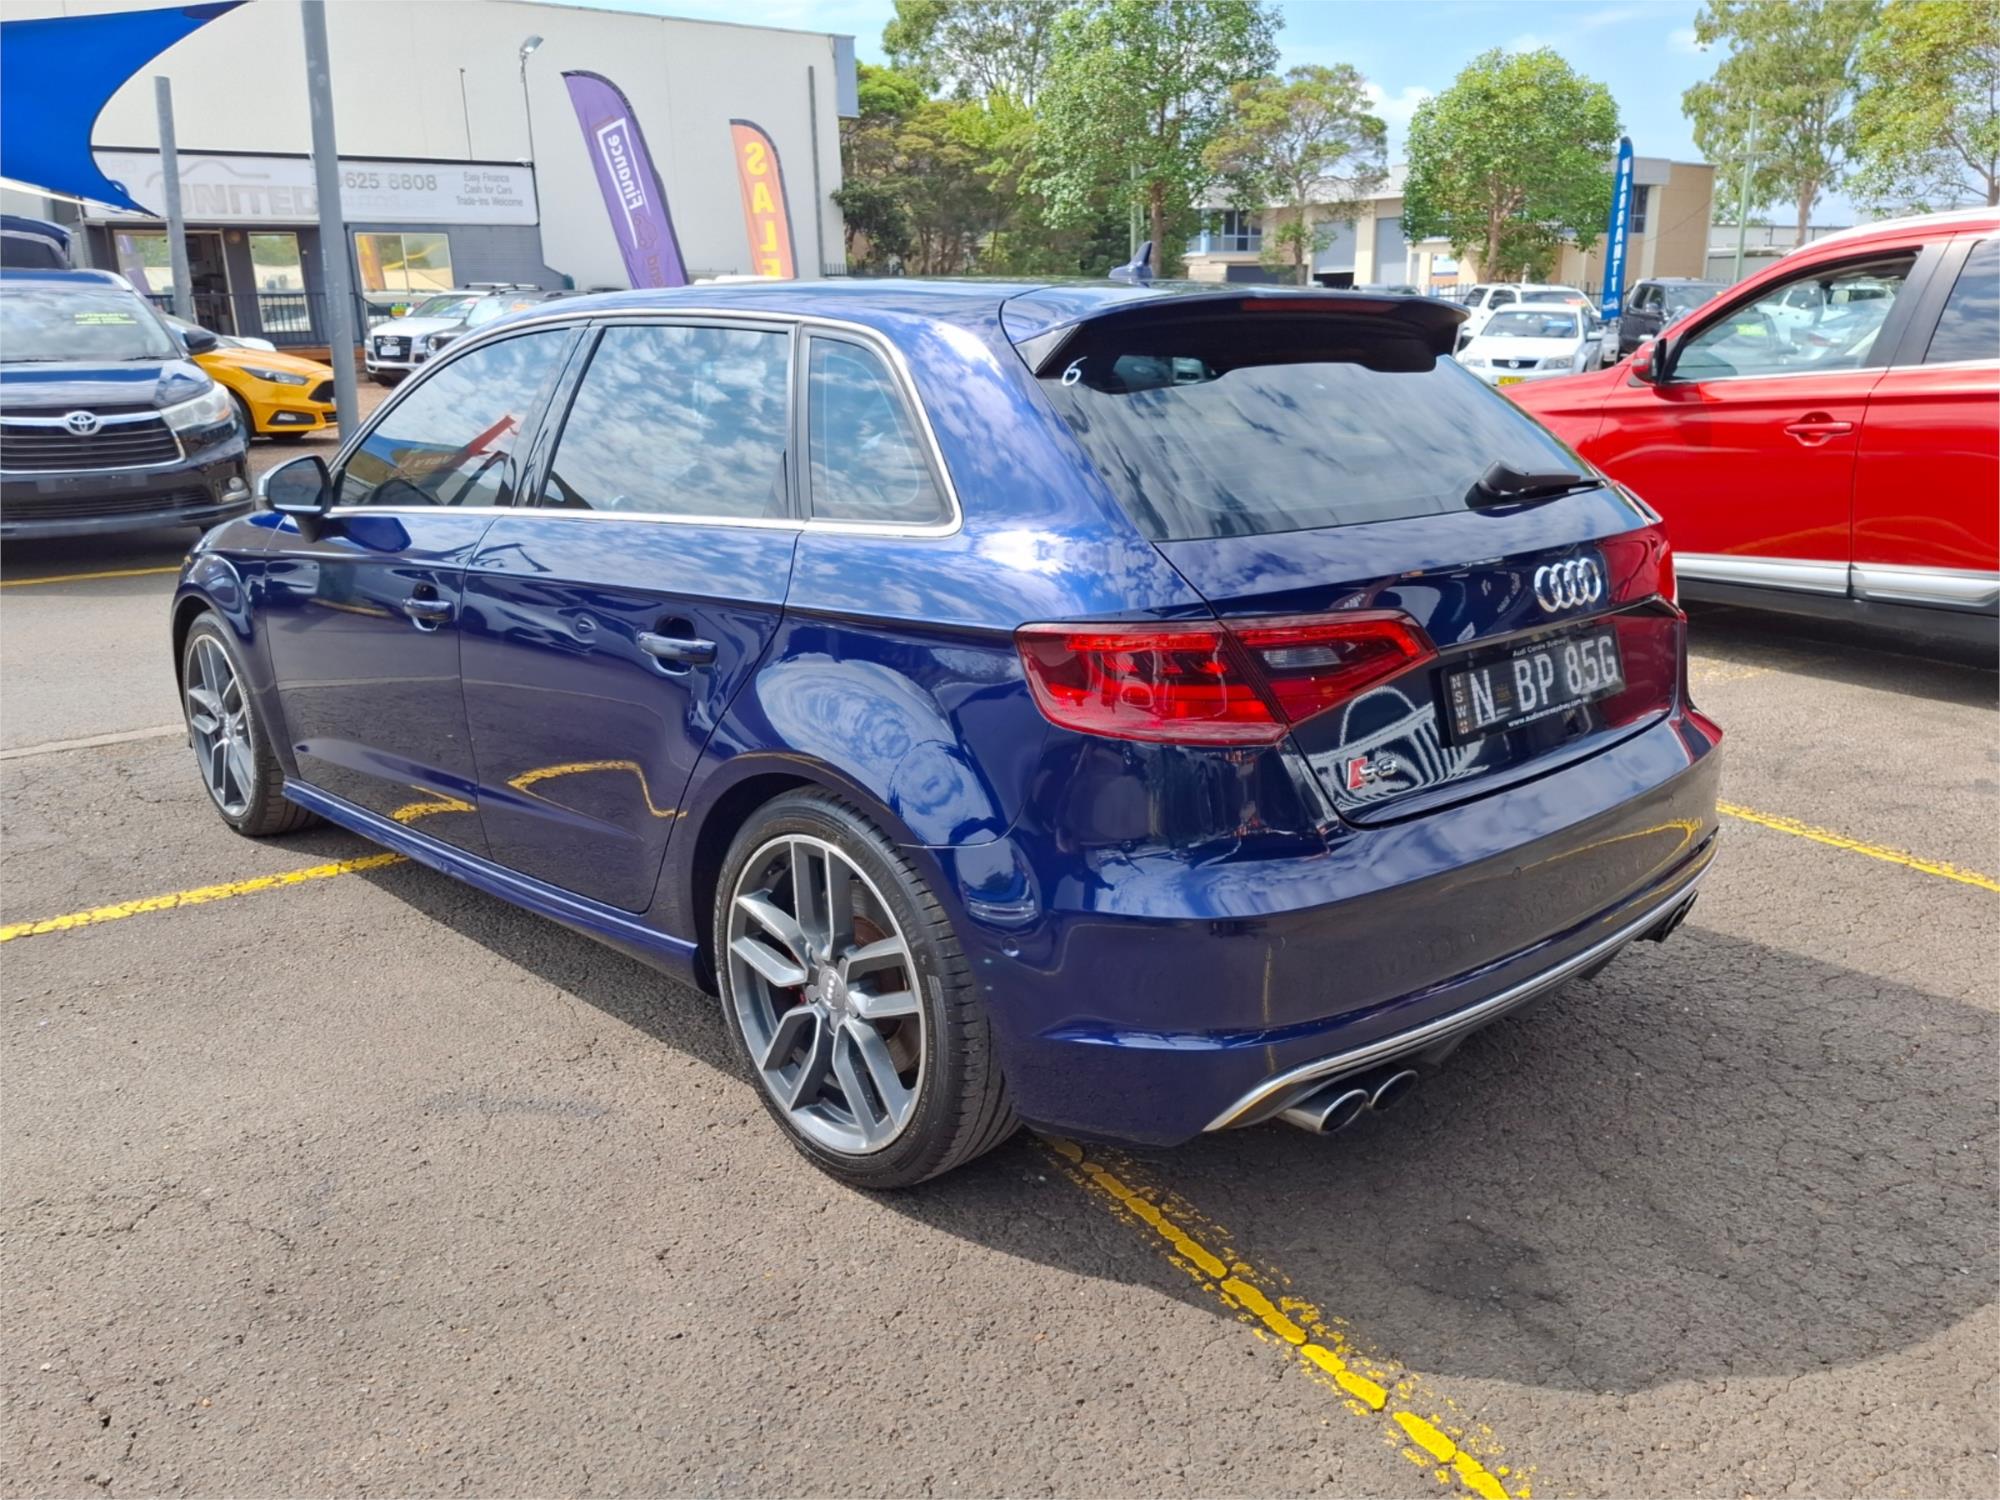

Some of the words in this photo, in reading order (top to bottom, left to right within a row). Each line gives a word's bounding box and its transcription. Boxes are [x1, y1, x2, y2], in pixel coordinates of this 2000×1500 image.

[339, 173, 380, 189] 625
[388, 173, 438, 190] 8808
[464, 172, 480, 183] Easy
[483, 173, 510, 183] Finance
[464, 184, 483, 194] Cash
[485, 185, 494, 194] for
[496, 186, 512, 195] Cars
[492, 197, 523, 207] Welcome
[1611, 156, 1631, 292] WARRANTY
[1062, 356, 1088, 386] 6
[1512, 647, 1527, 657] Audi
[1564, 635, 1618, 694] 85G
